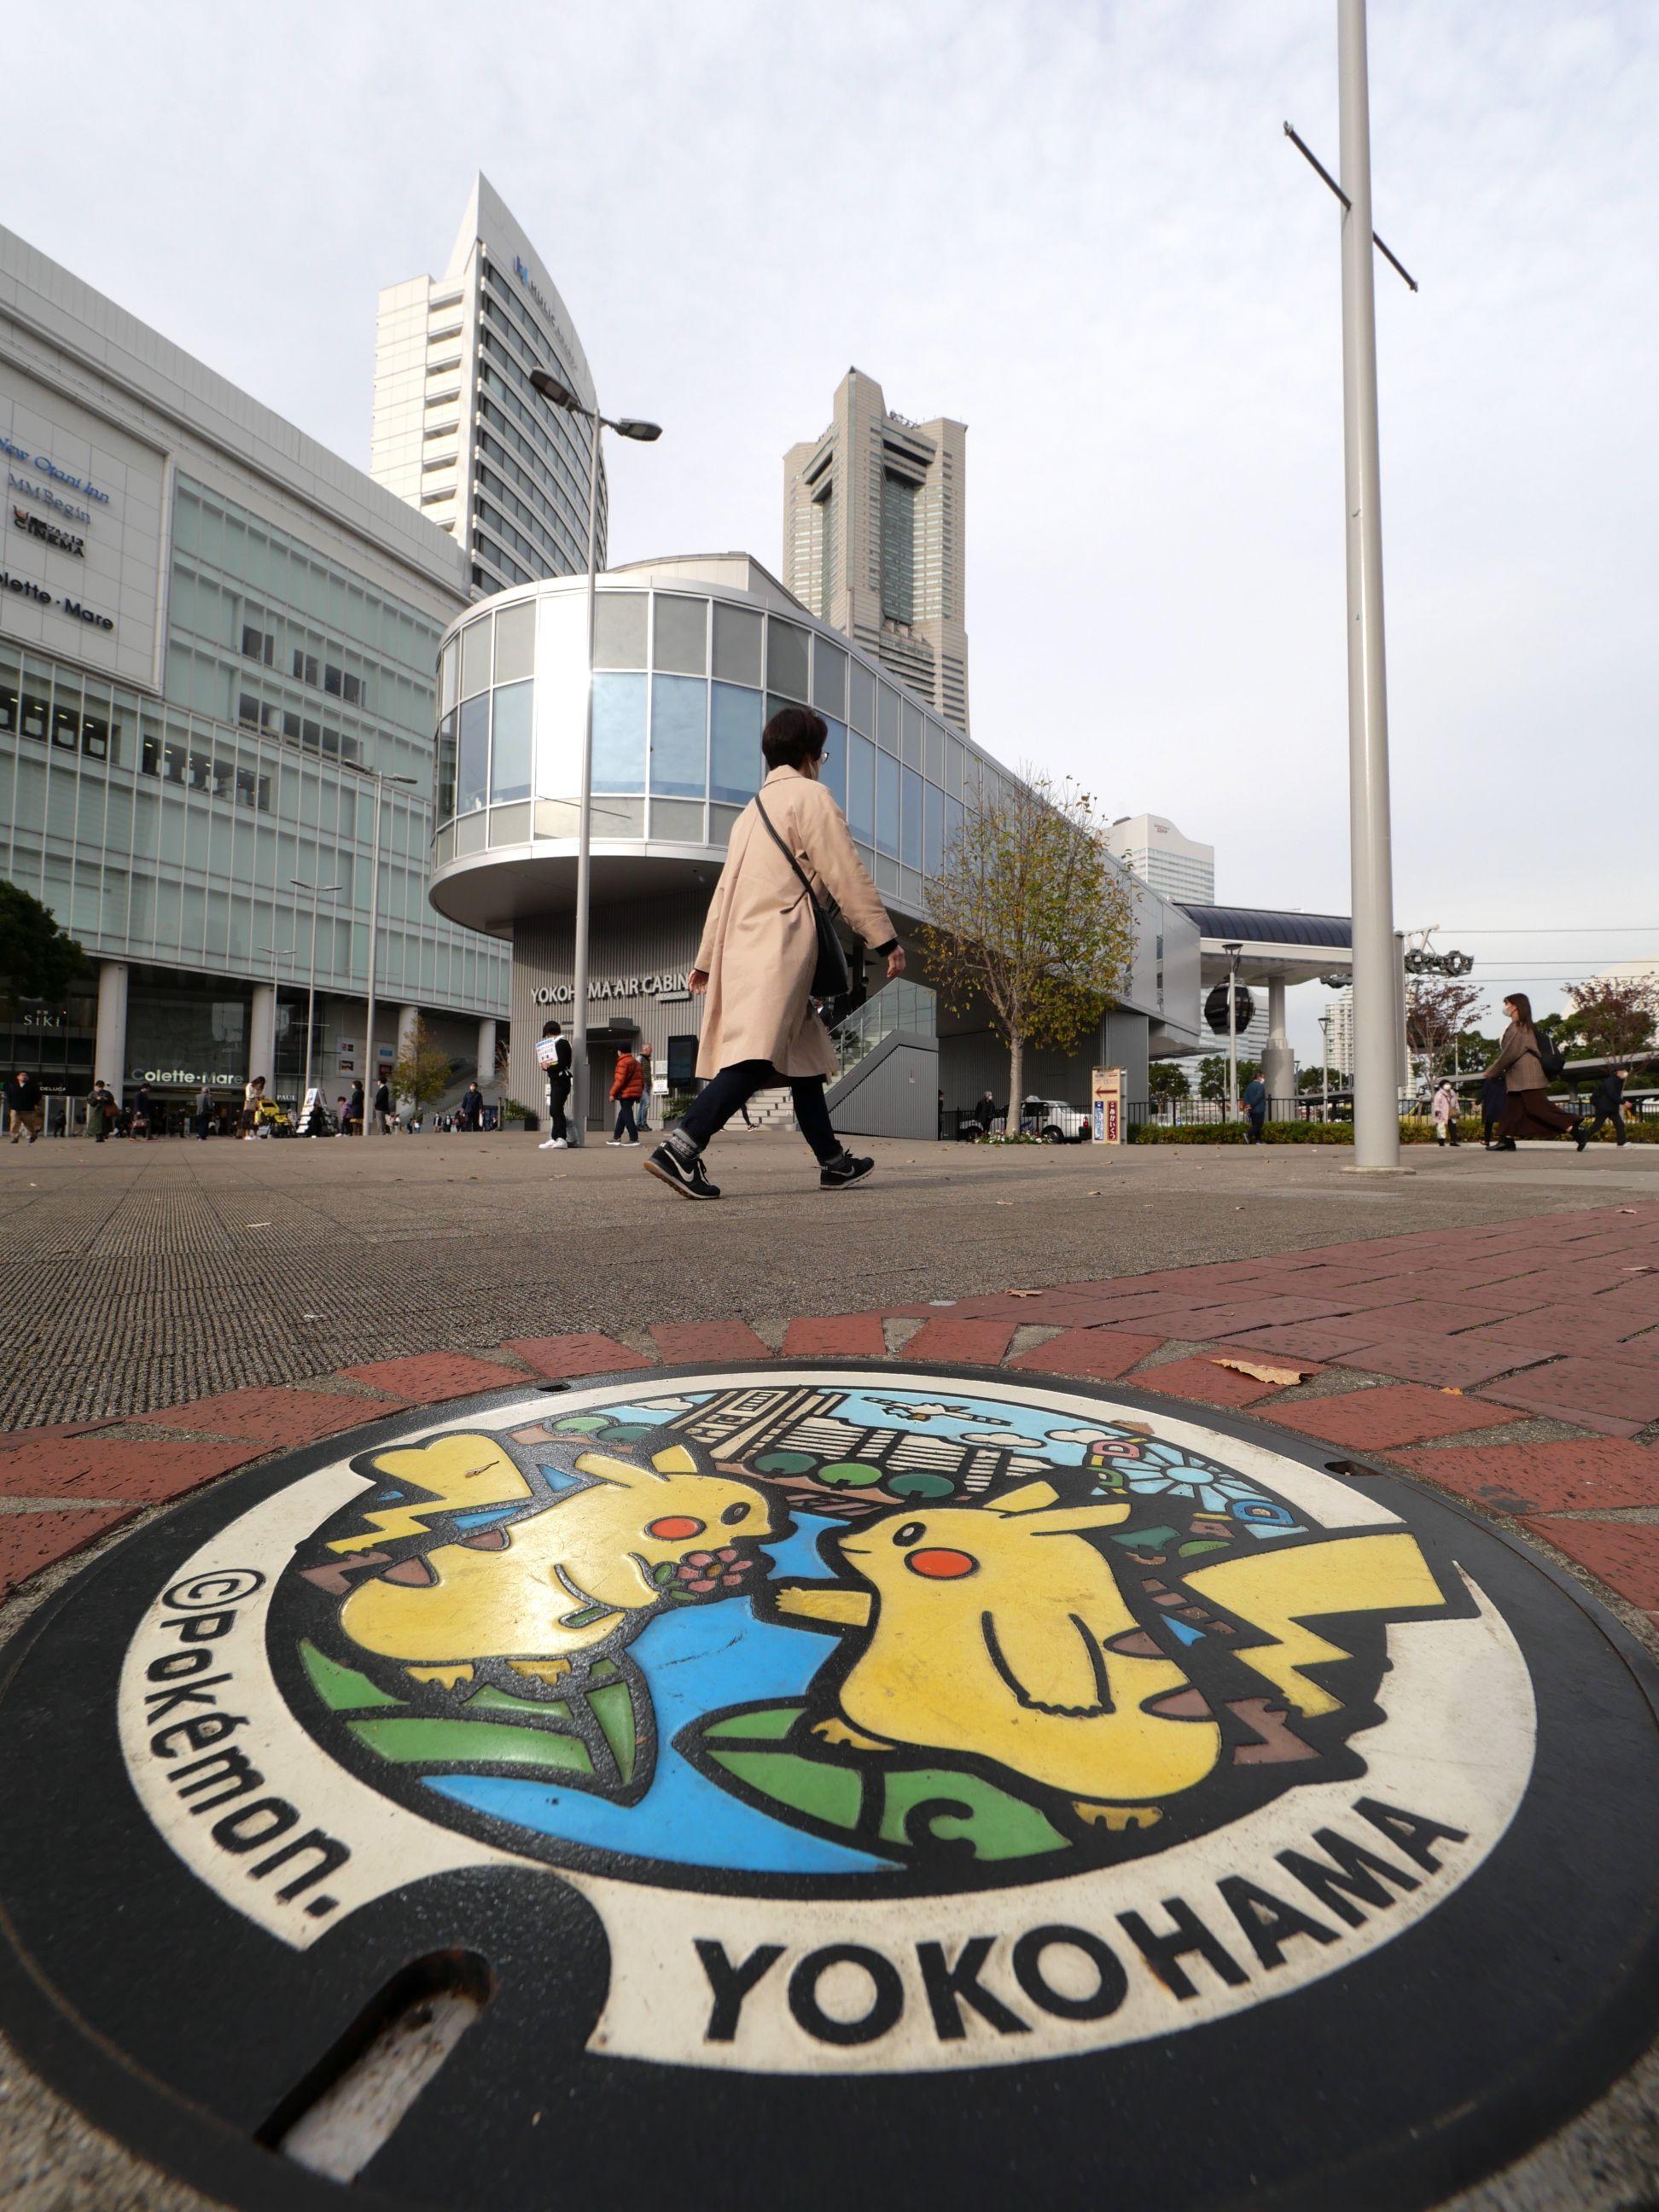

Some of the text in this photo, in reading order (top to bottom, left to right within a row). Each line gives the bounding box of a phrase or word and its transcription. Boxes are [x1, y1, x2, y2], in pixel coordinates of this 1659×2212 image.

[34, 456, 81, 489] Otani
[83, 480, 109, 504] Inn
[14, 517, 84, 558] CINEMA
[0, 571, 51, 605] lette
[532, 973, 689, 1004] YOKOHMA AIR CABIN
[693, 1796, 1470, 2045] YOKOHAMA
